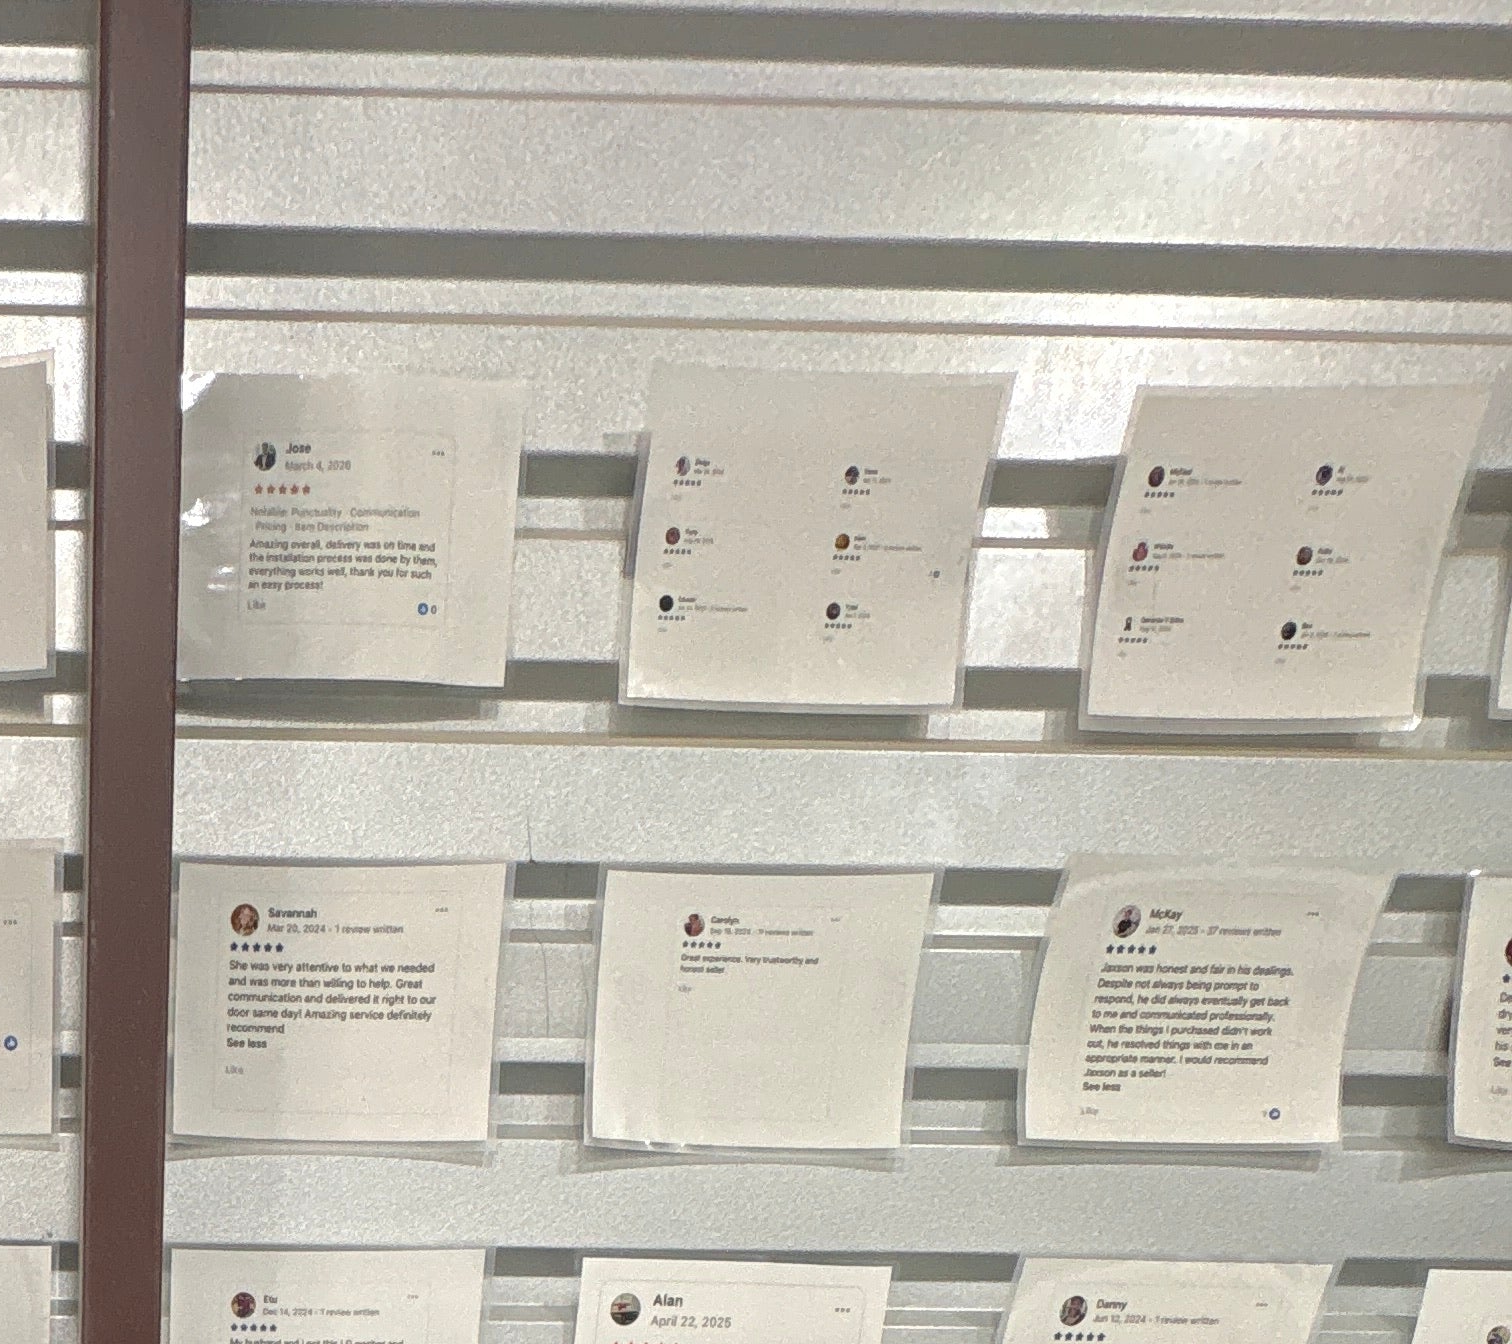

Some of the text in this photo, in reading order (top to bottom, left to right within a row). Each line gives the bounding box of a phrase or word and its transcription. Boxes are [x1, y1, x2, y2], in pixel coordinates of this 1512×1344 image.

[286, 443, 311, 453] Jose
[268, 907, 317, 918] Savannah
[1149, 909, 1182, 921] McKay
[229, 961, 435, 973] She was very attentive to what we needed
[228, 977, 246, 986] and
[270, 979, 296, 987] more
[298, 977, 320, 987] than
[323, 978, 354, 989] willing
[356, 979, 366, 987] to
[395, 978, 422, 988] Great
[227, 993, 436, 1006] communication and delivered it right to our
[227, 1008, 249, 1018] door
[252, 1010, 278, 1018] same
[304, 1009, 347, 1021] Amazing
[349, 1010, 384, 1019] service
[386, 1009, 431, 1021] definitely
[226, 1022, 284, 1032] recommend
[226, 1037, 267, 1048] See less
[653, 1294, 683, 1306] Alan
[1096, 1299, 1127, 1310] Danny
[650, 1314, 677, 1329] April
